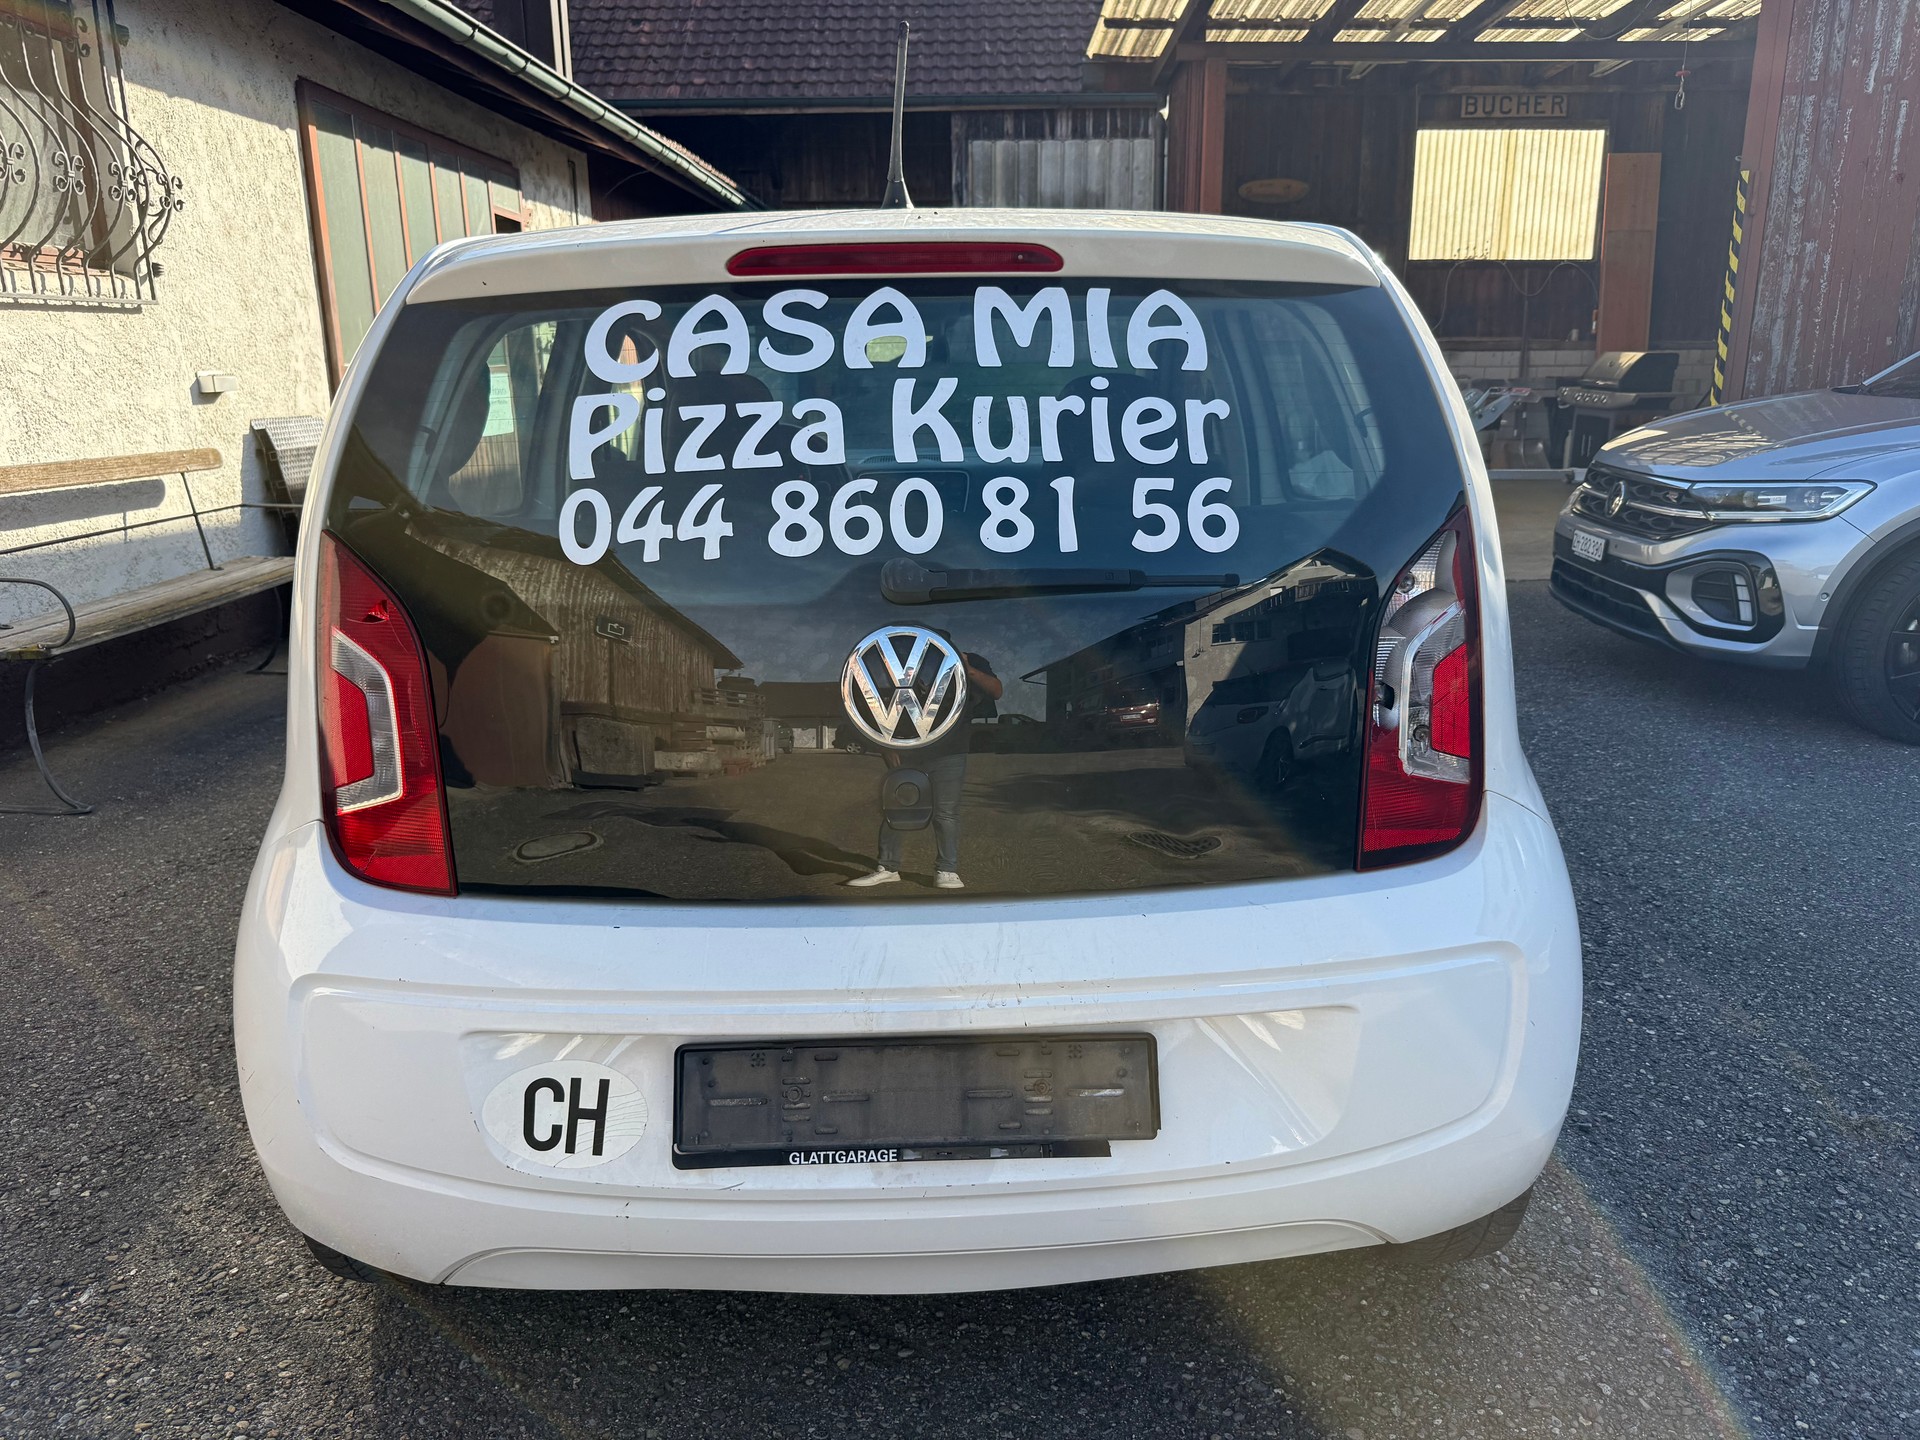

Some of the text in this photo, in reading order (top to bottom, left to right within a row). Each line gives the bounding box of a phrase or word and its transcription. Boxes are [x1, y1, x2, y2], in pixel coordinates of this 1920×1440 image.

[1464, 95, 1565, 116] BUCHER
[584, 286, 1209, 383] CASA MIA
[568, 376, 1230, 480] Pizza Kurier
[558, 476, 1240, 566] 044 860 81 56
[522, 1077, 611, 1157] CH
[788, 1149, 898, 1165] GLATTGARAGE
